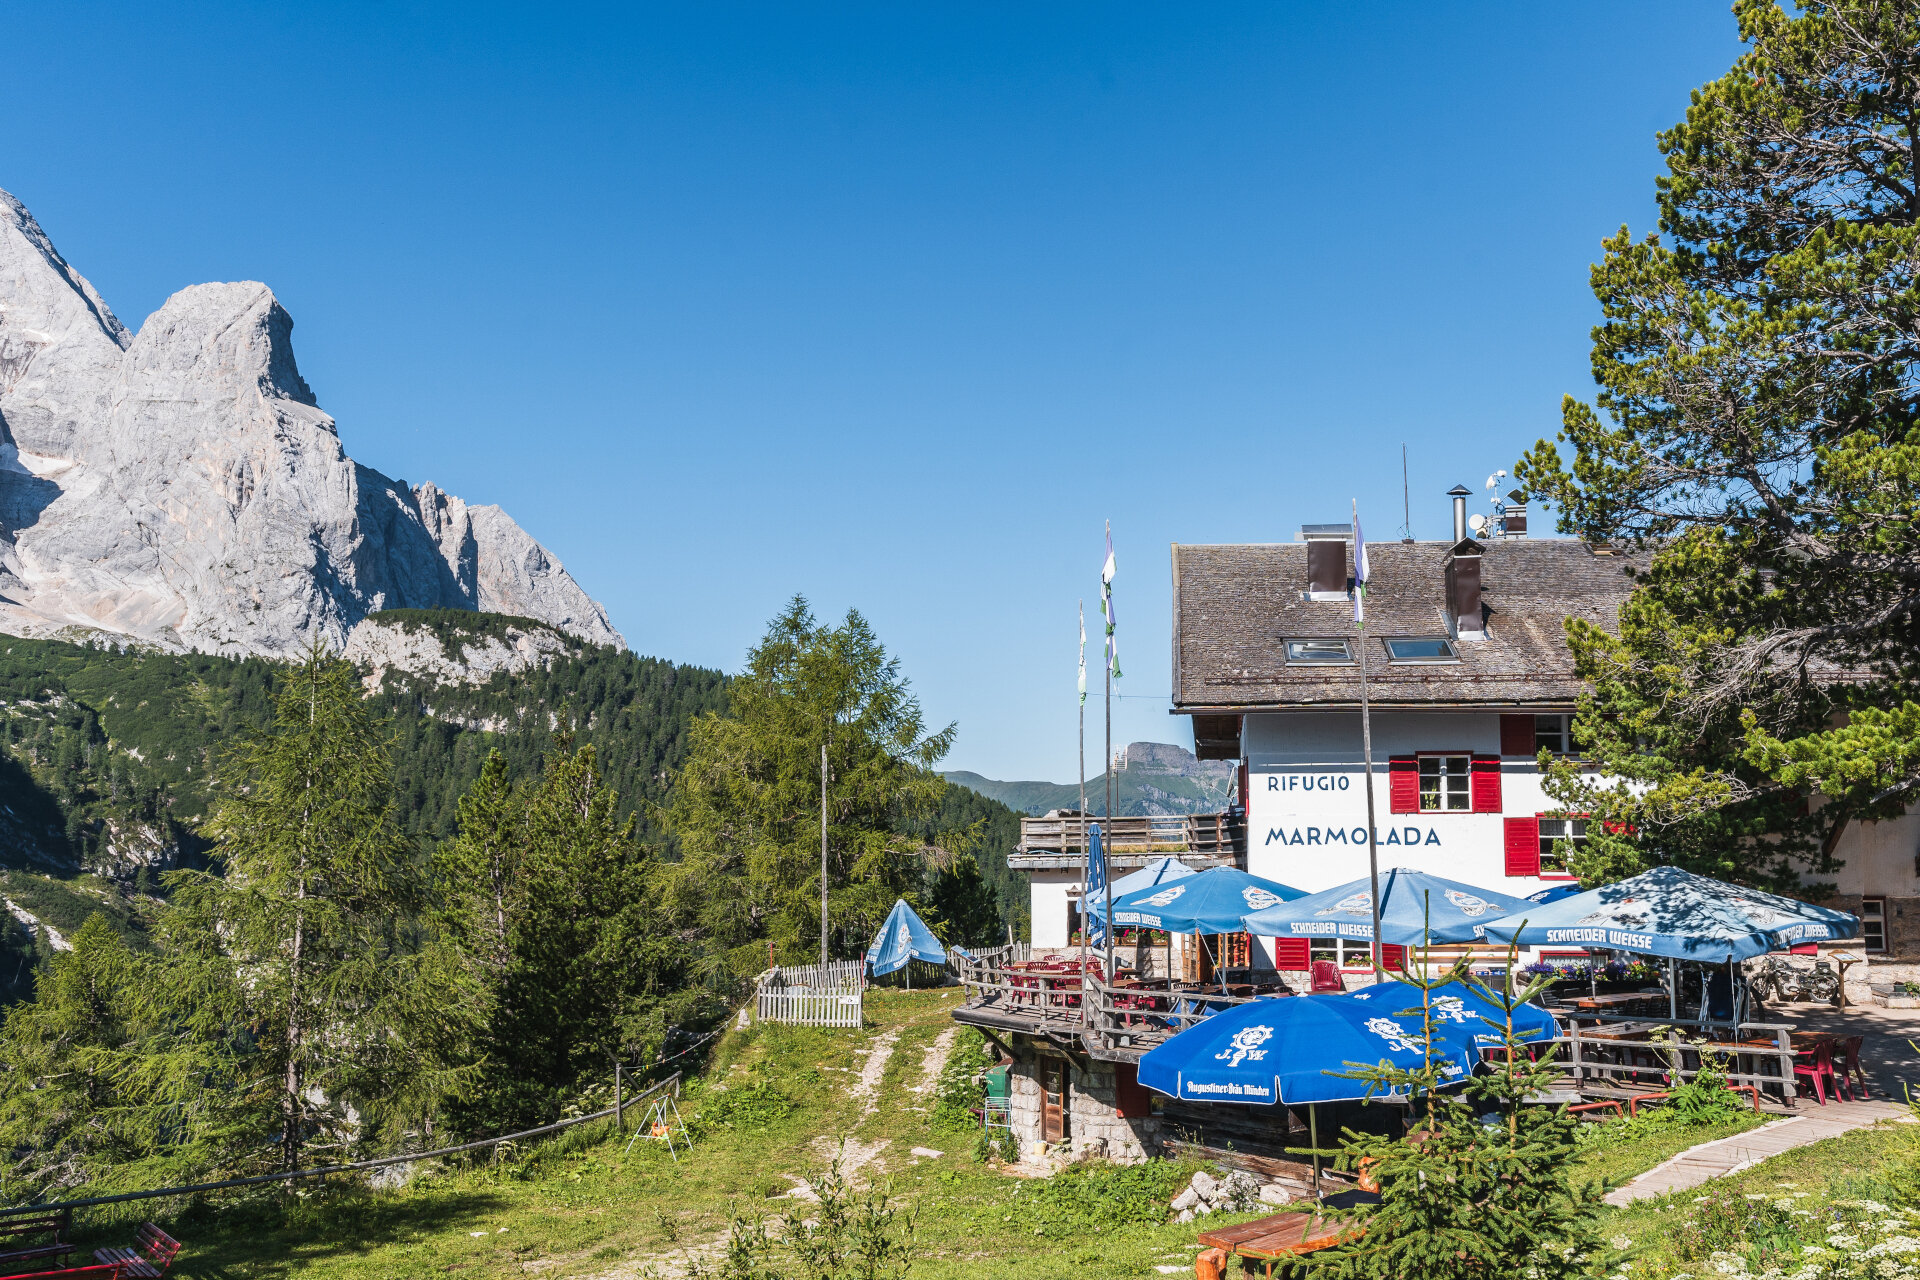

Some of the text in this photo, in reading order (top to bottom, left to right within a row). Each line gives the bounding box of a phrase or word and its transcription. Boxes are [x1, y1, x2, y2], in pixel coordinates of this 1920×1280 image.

[1268, 776, 1350, 791] RIFUGIO
[1265, 827, 1441, 846] MARMOLADA
[1141, 913, 1162, 927] WEISSE
[1290, 922, 1374, 937] SCHNEIDER WEISSE
[1804, 924, 1829, 938] WEISSE
[1546, 928, 1653, 949] SCHNEIDER WEISSE
